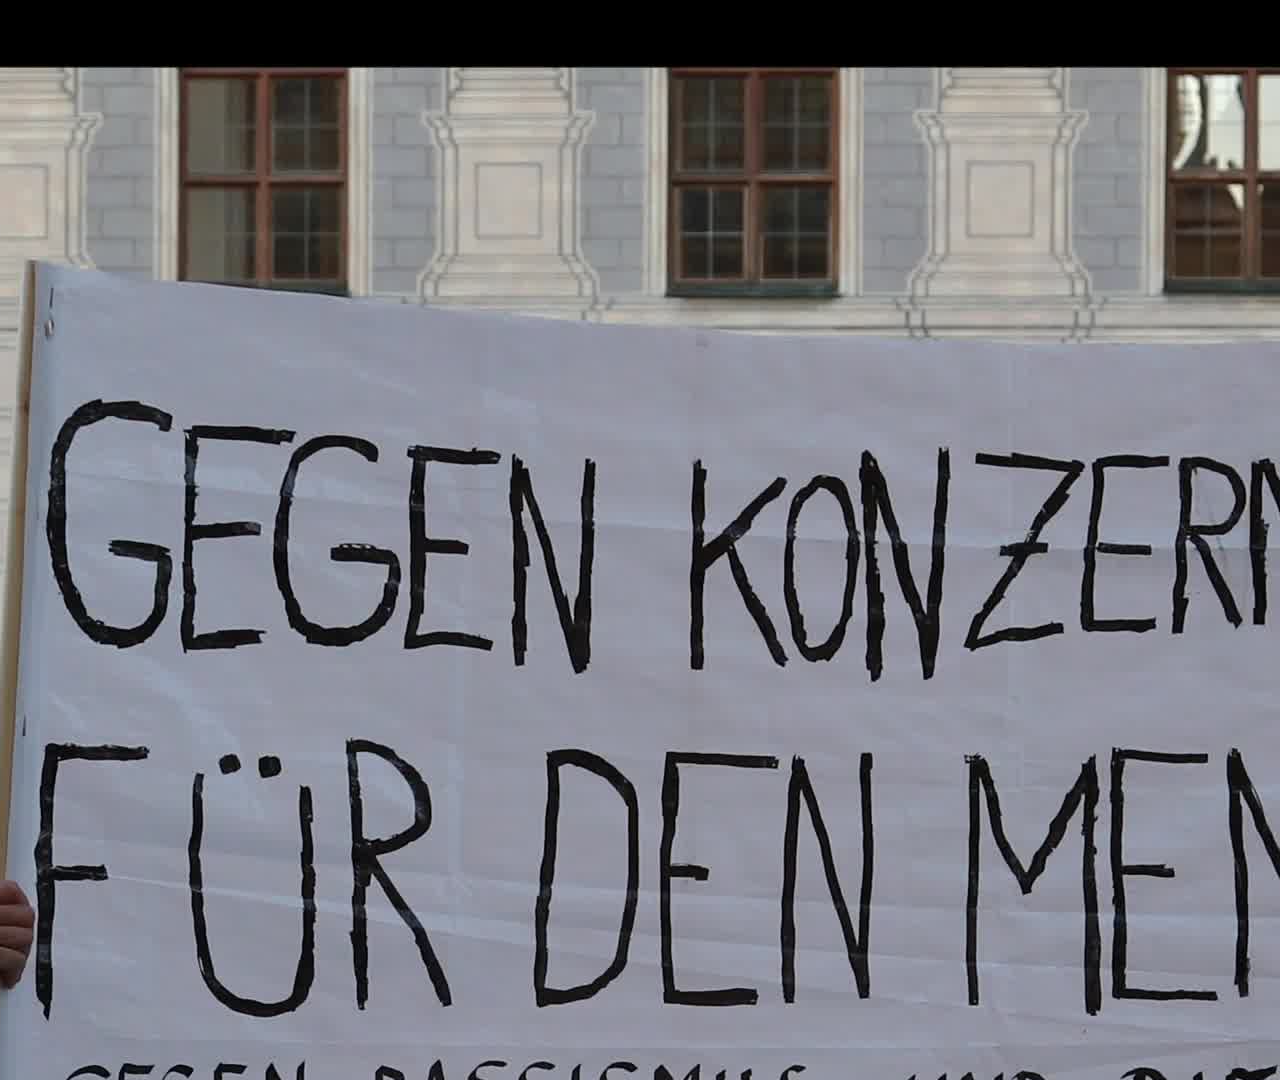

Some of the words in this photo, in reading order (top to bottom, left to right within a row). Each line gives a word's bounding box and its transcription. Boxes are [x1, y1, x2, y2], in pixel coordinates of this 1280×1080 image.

[46, 398, 596, 675] GEGEN
[33, 737, 453, 1021] FÜR
[533, 748, 874, 1009] DEN
